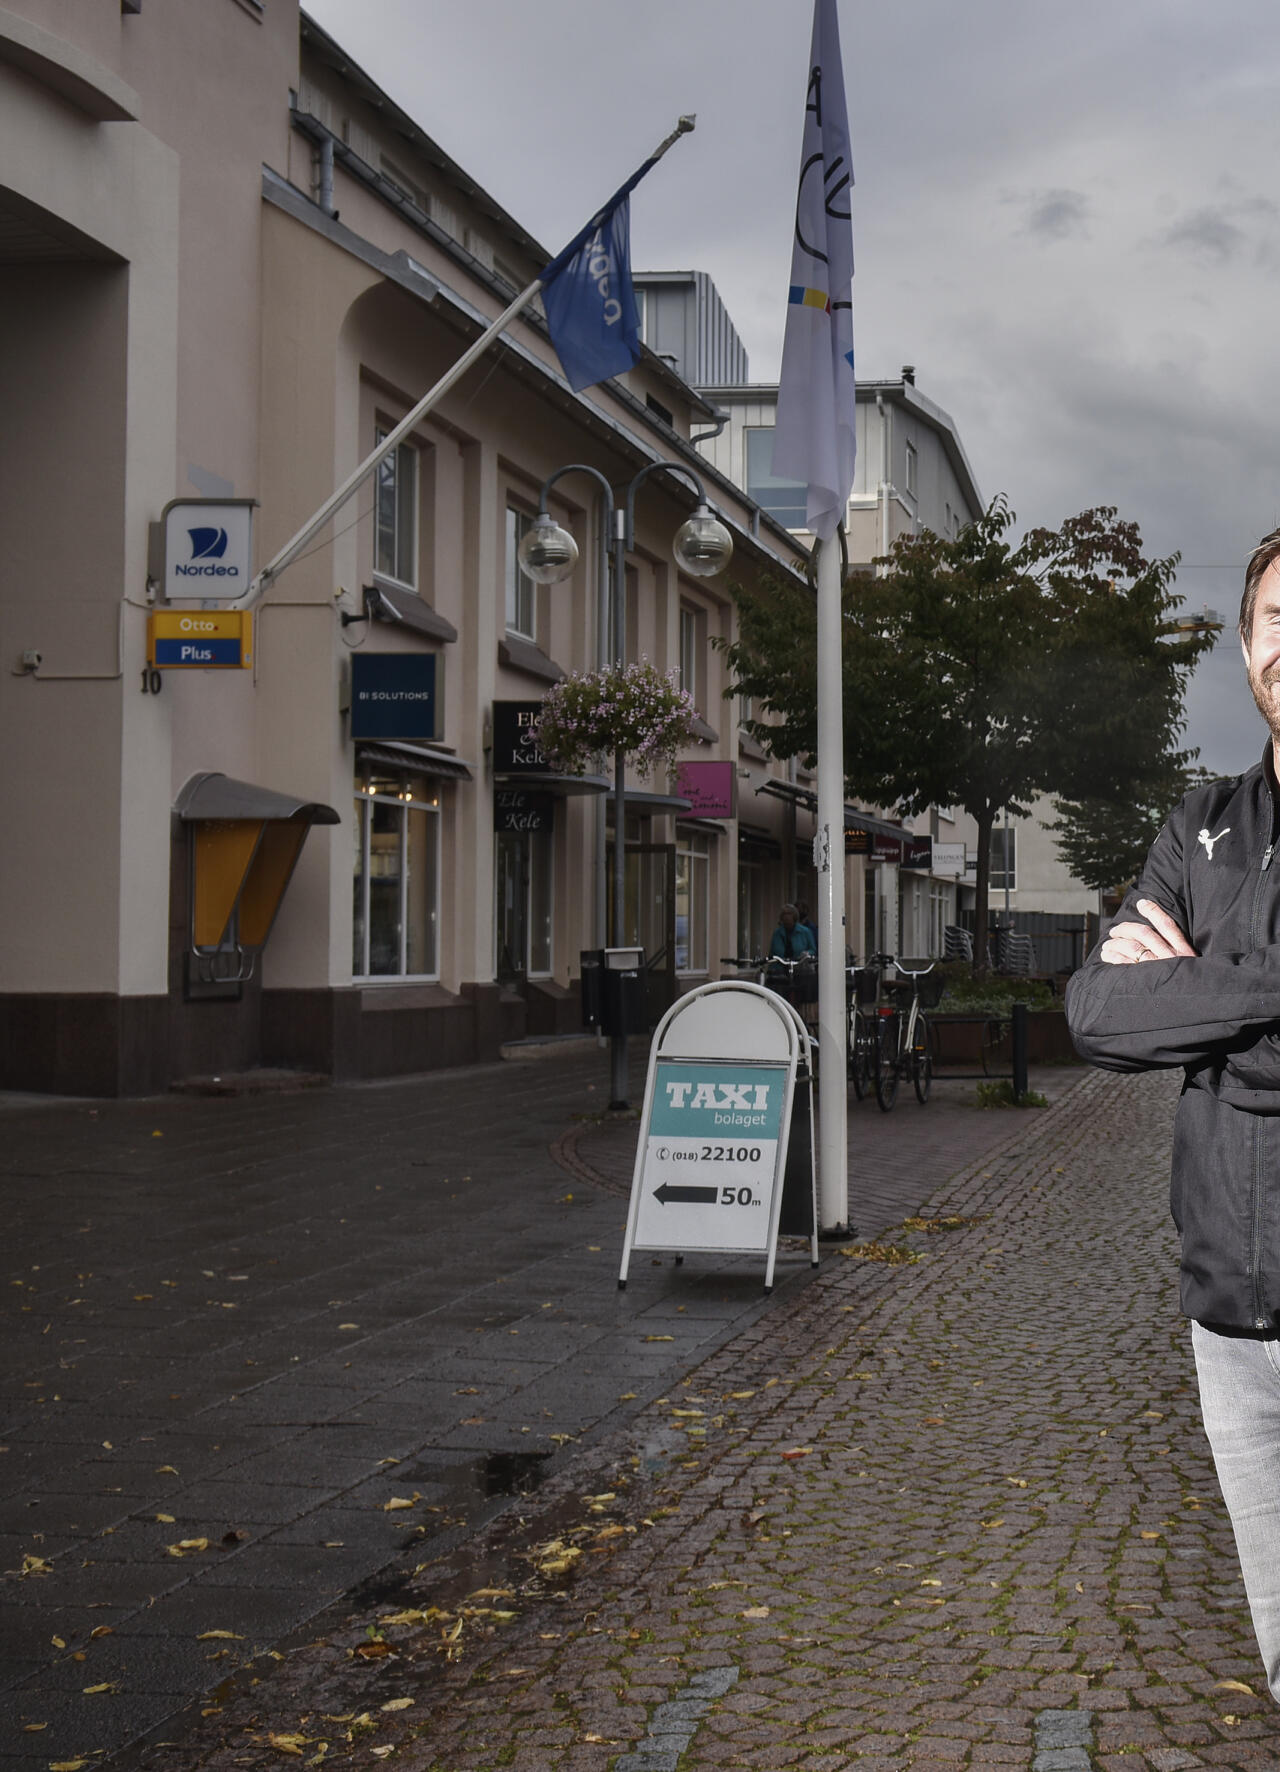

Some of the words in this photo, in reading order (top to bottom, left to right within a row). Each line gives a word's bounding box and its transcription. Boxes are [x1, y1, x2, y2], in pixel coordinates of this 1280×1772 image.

[175, 564, 239, 577] Nordea
[140, 668, 162, 694] 10
[359, 692, 369, 700] BI
[371, 692, 429, 700] SOLUTIONS
[499, 792, 525, 808] Ele
[505, 812, 542, 831] Kele
[666, 1082, 770, 1110] TAXI
[714, 1111, 767, 1127] bolaget
[672, 1151, 698, 1162] (018)
[700, 1146, 761, 1162] 22100
